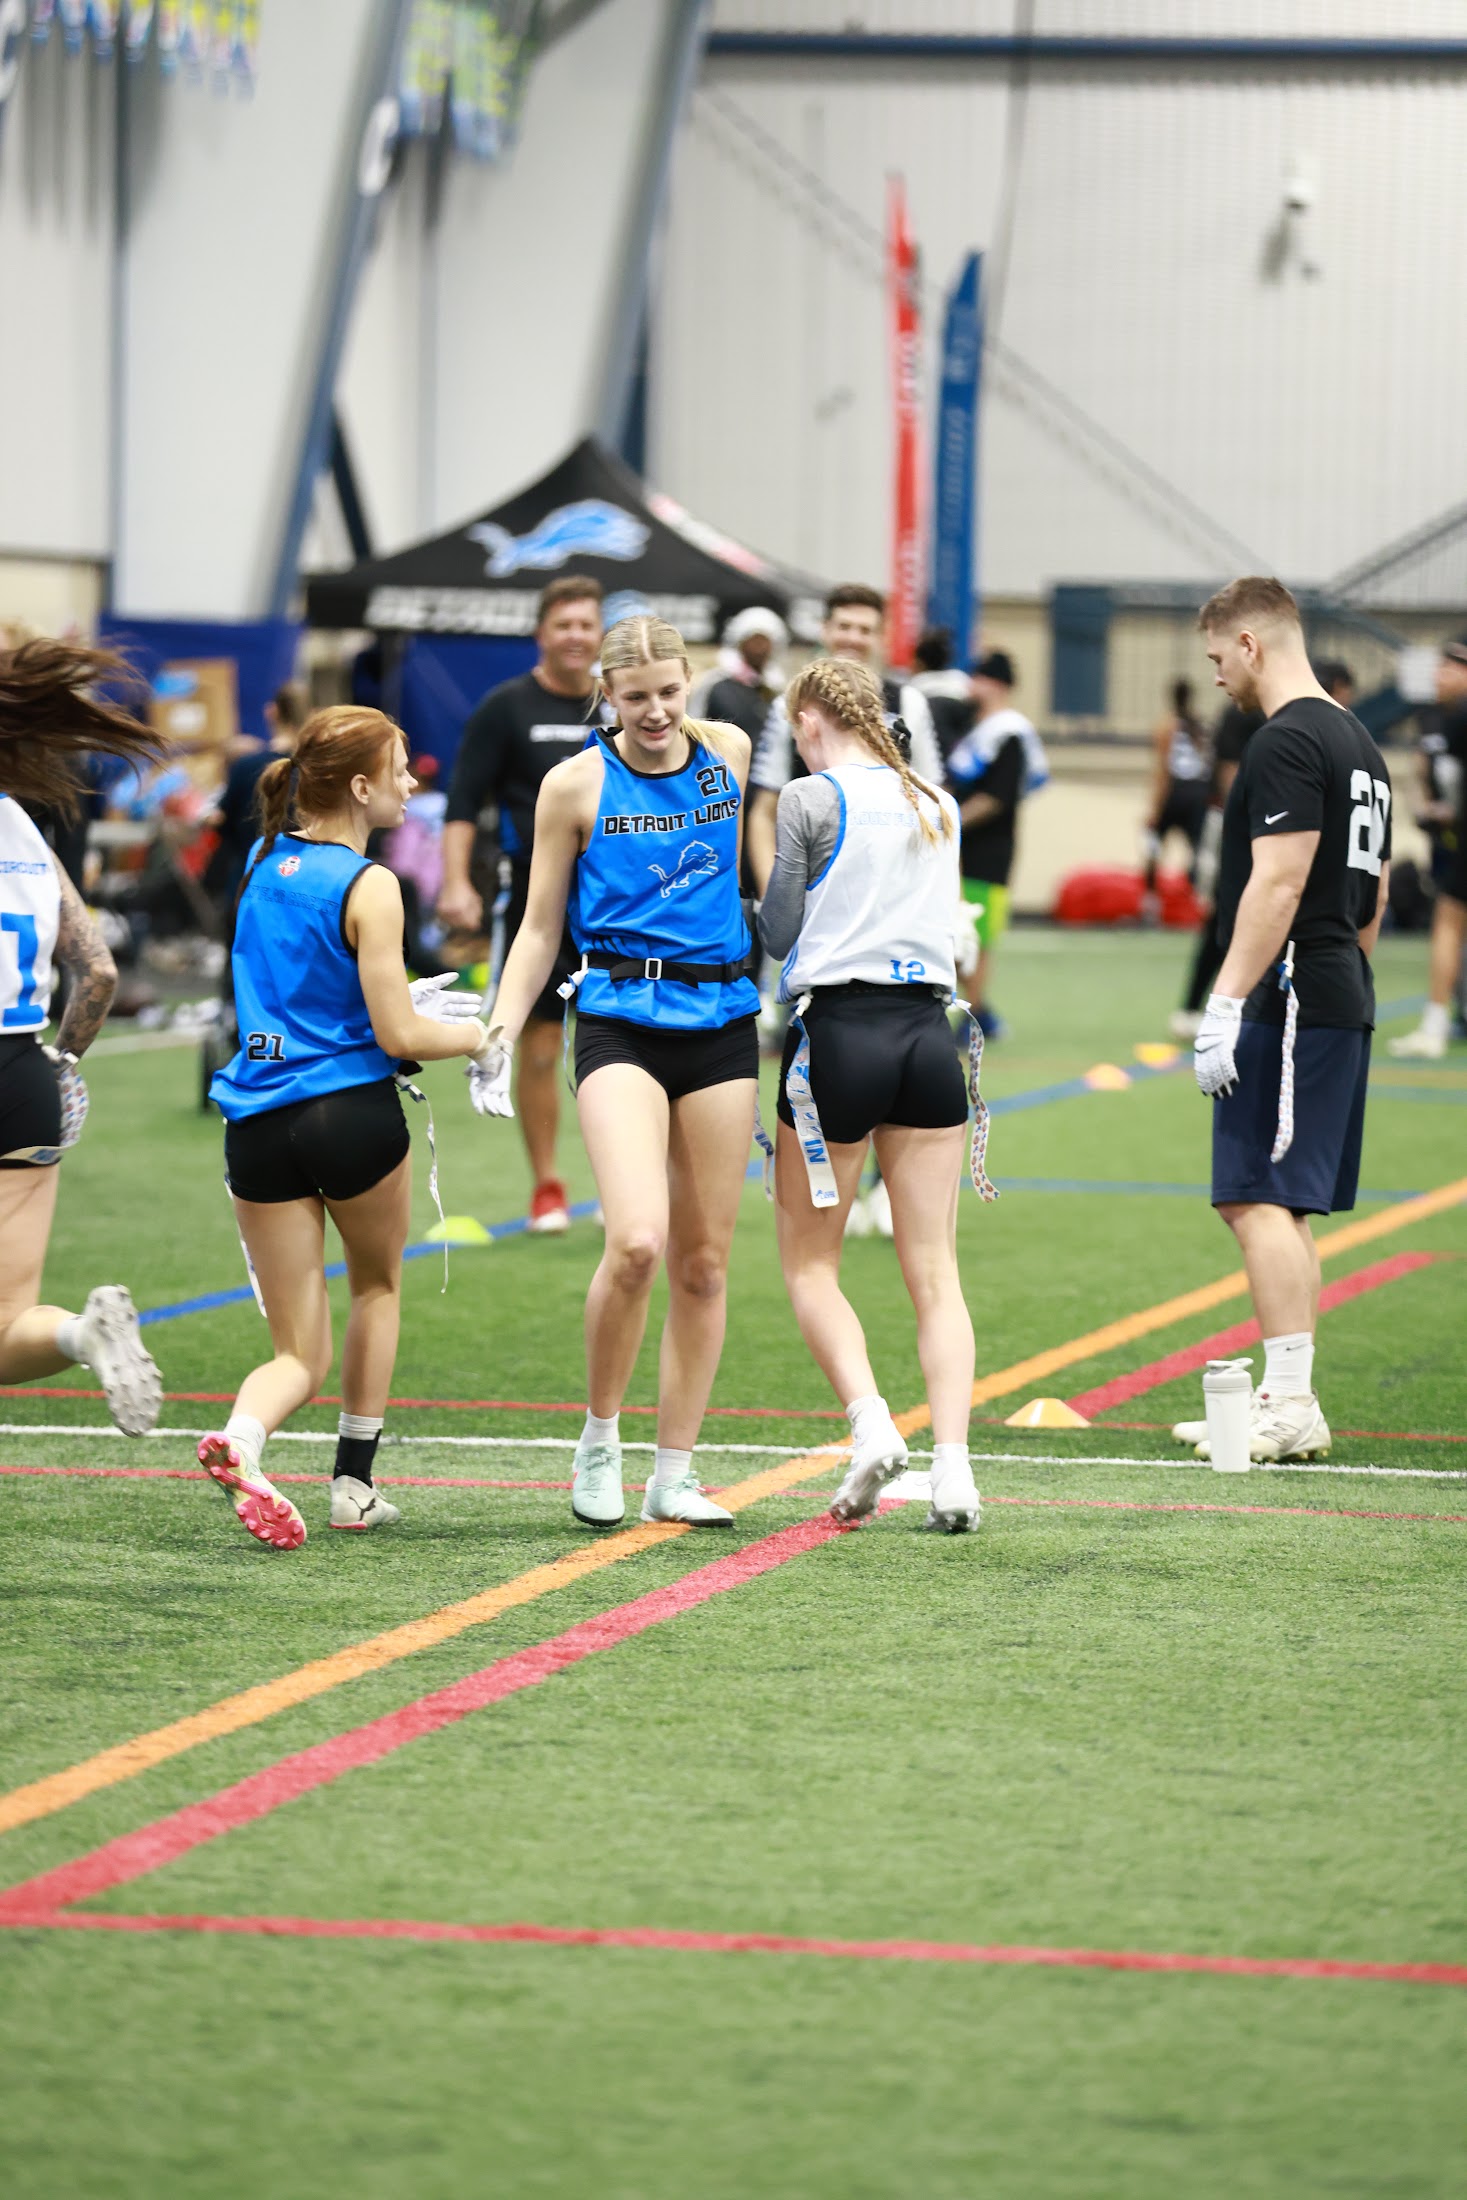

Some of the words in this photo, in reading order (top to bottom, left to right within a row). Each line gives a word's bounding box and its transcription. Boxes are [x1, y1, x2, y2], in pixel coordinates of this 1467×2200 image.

[695, 764, 731, 798] 27
[601, 812, 688, 836] DETROIT
[691, 798, 738, 826] LIONS
[0, 911, 45, 1028] 1
[890, 959, 926, 985] 12
[246, 1031, 287, 1062] 21
